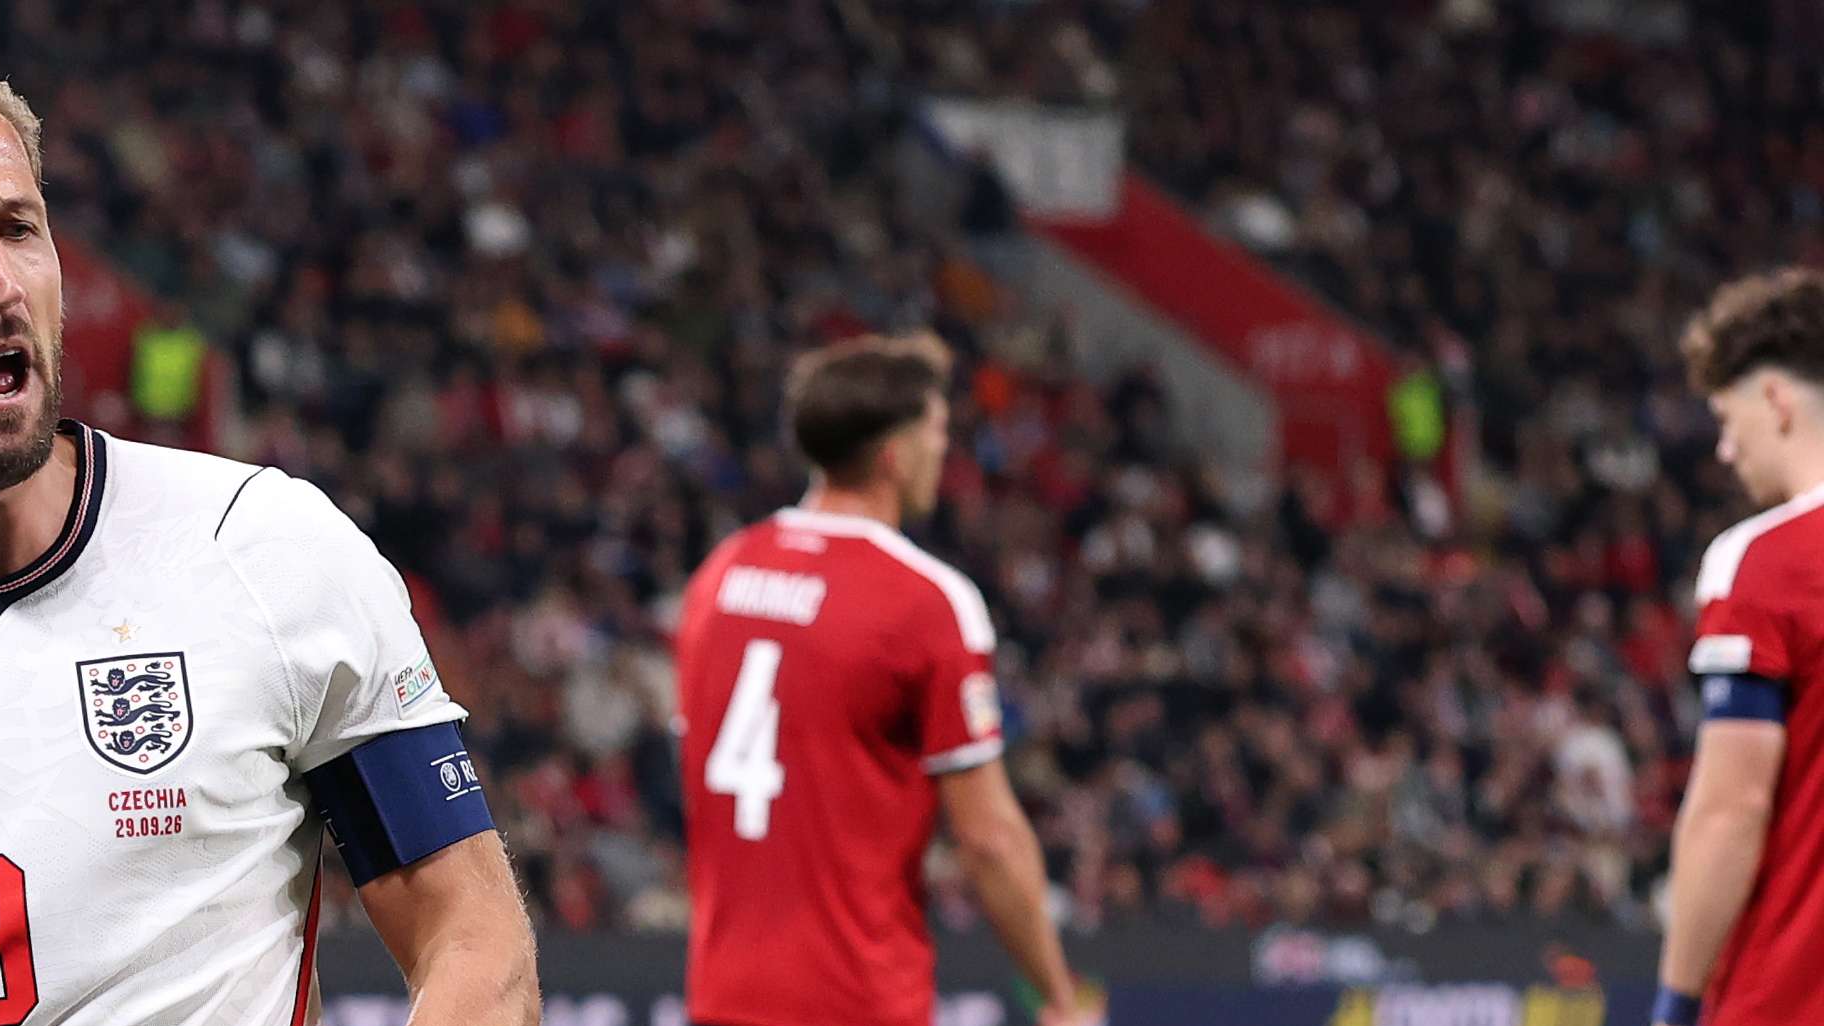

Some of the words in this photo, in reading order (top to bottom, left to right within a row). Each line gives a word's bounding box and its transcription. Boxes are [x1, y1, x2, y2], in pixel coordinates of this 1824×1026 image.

[394, 666, 413, 685] UEFA
[705, 638, 786, 841] 4
[108, 788, 188, 811] CZECHIA
[115, 815, 183, 838] 29.09.26
